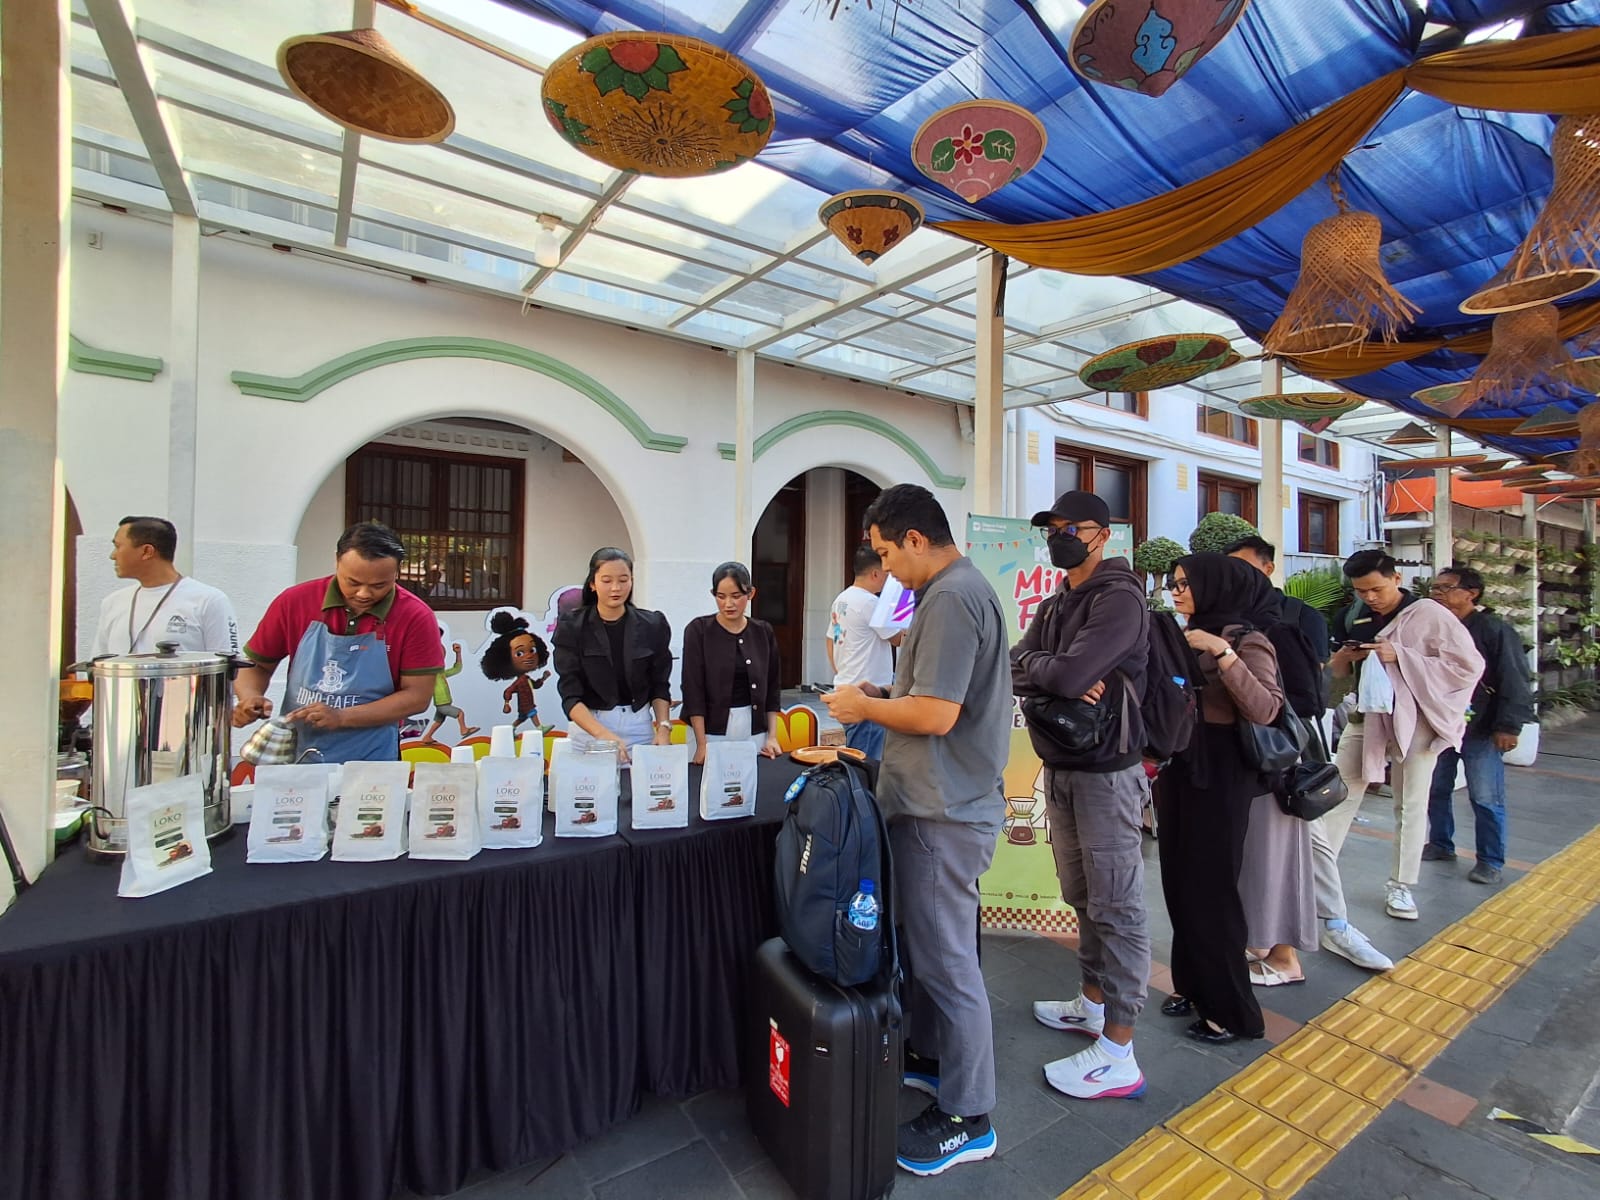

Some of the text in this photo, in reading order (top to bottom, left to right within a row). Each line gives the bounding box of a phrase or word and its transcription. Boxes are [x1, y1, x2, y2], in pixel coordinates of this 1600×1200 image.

[496, 787, 520, 795] LOKO
[575, 784, 596, 792] LOKO
[275, 796, 304, 805] LOKO
[360, 793, 386, 801] LOKO
[431, 794, 456, 802] LOKO
[153, 812, 182, 828] LOKO
[799, 833, 813, 875] THULE
[939, 1131, 970, 1155] HOKA
